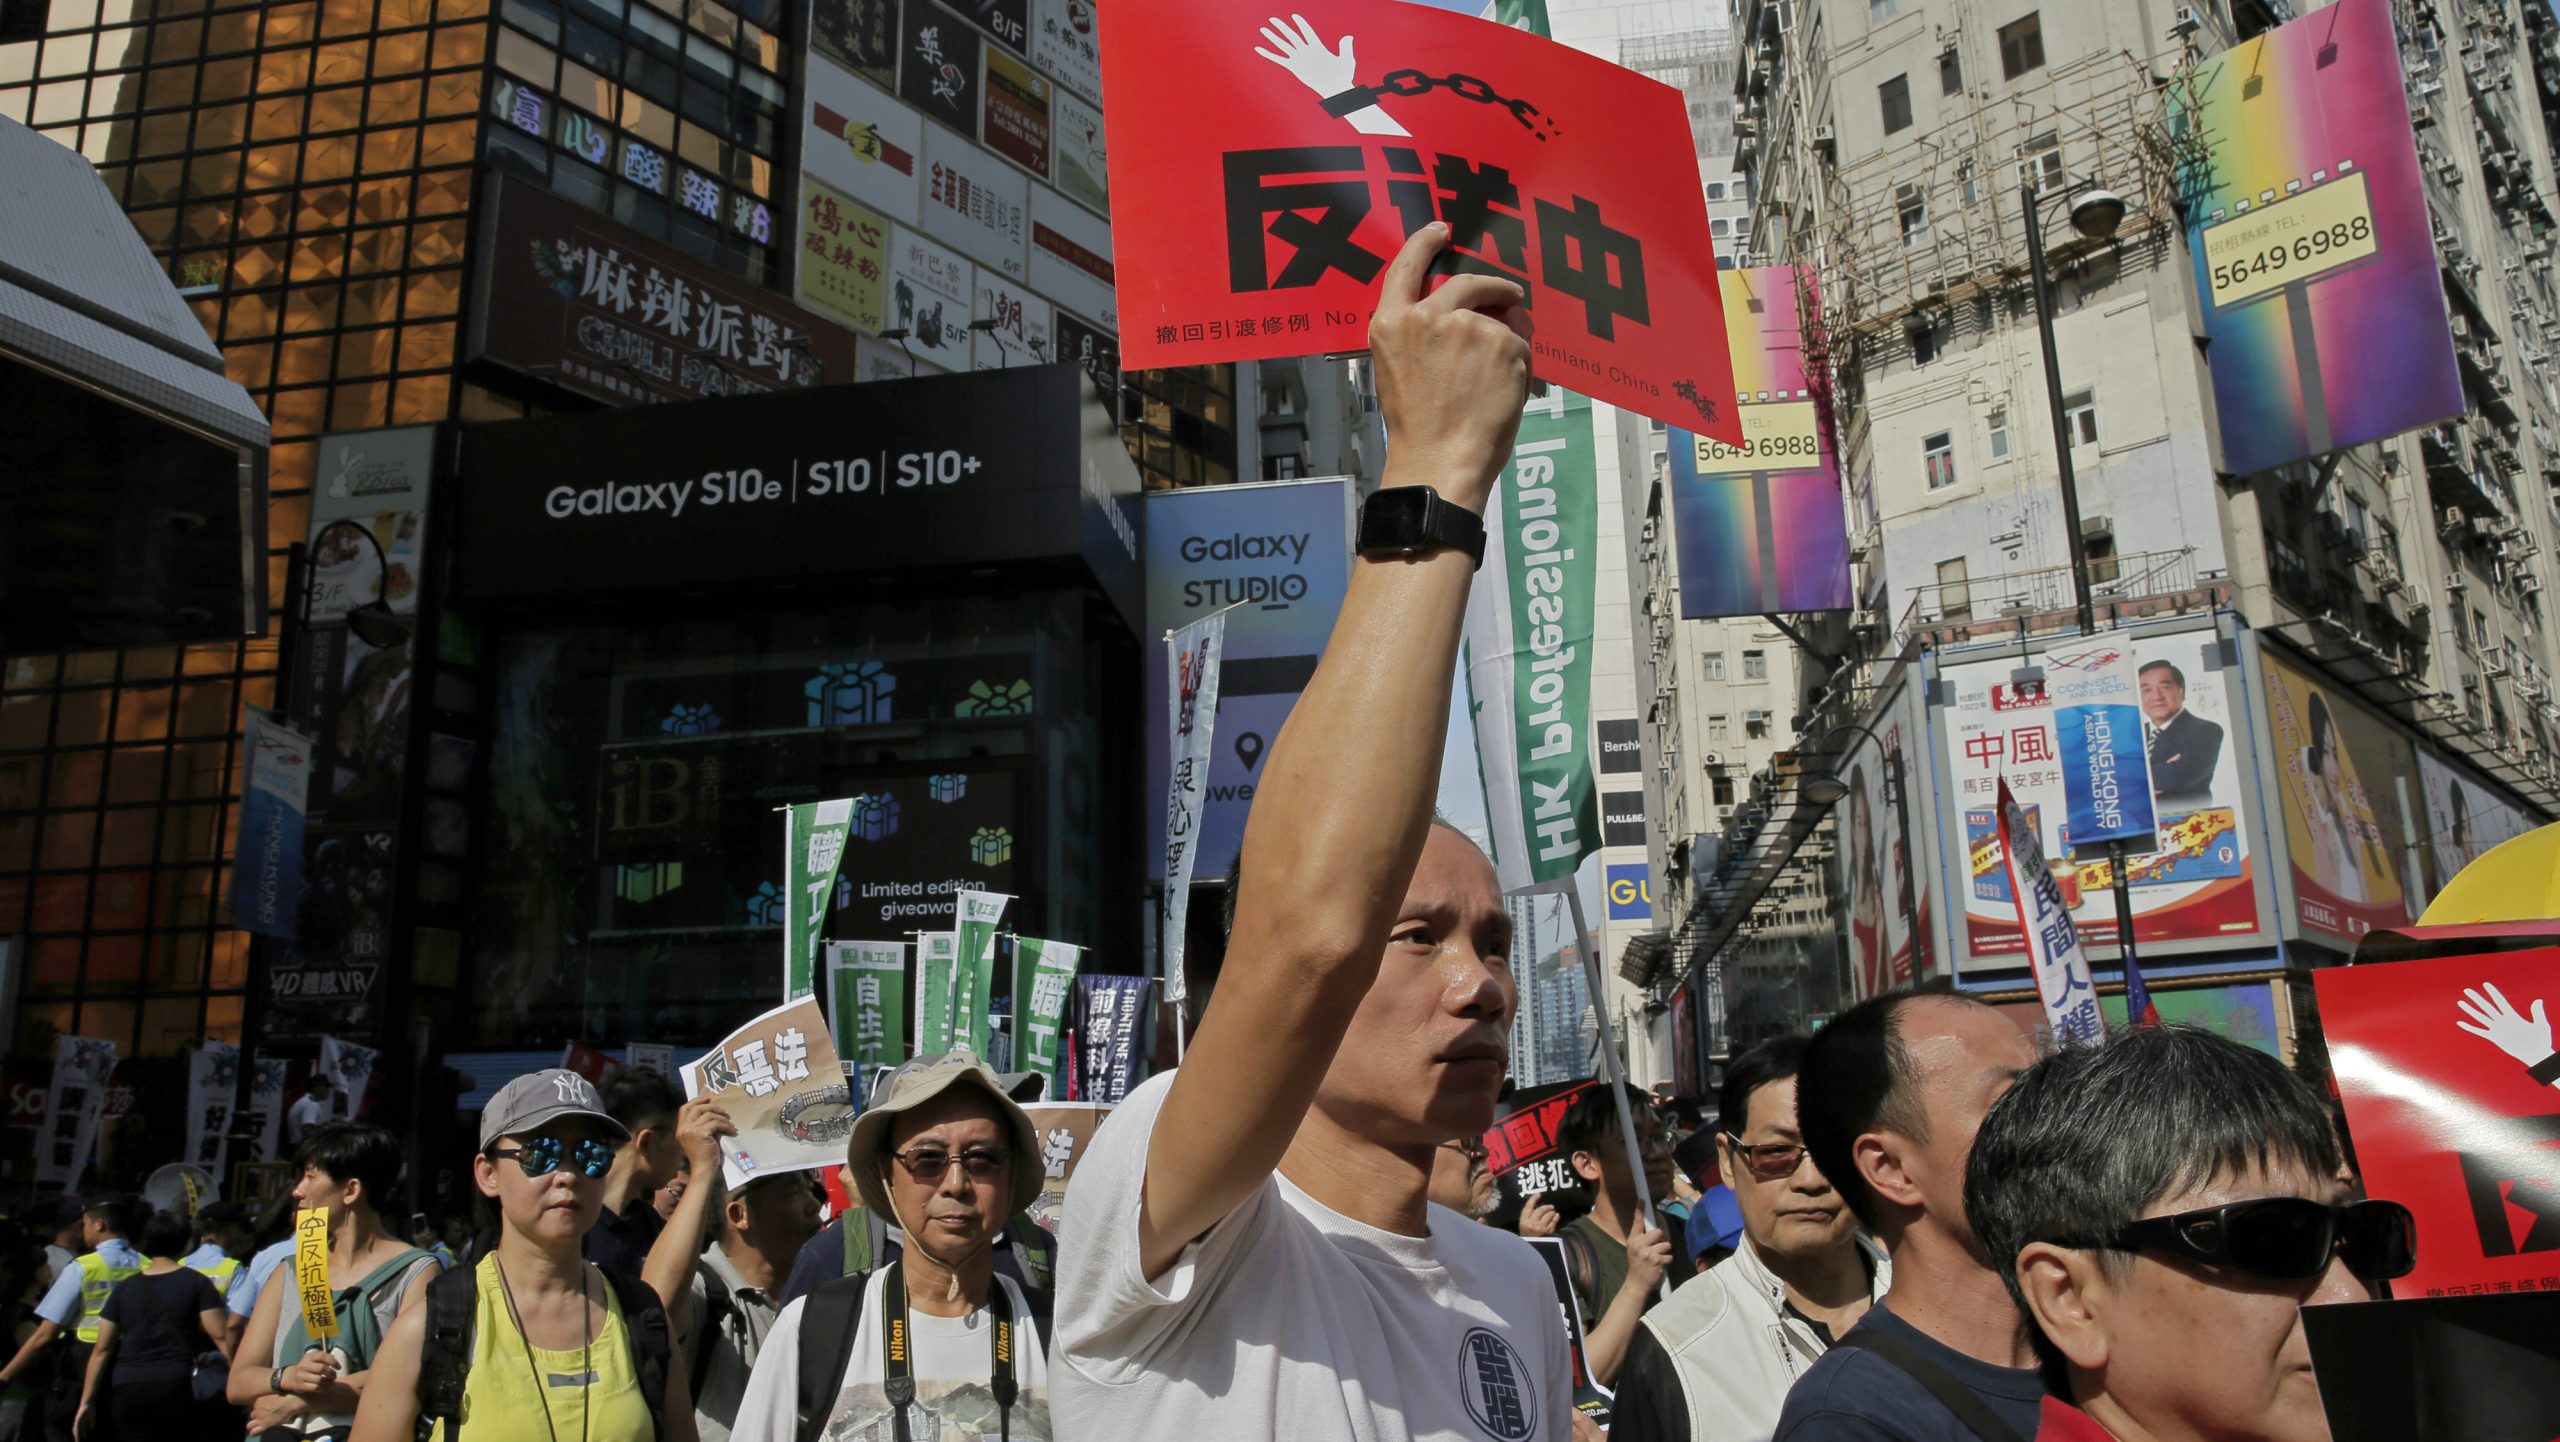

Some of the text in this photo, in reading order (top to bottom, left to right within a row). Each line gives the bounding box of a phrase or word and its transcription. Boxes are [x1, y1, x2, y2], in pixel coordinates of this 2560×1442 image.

[992, 10, 1024, 43] 8/F
[805, 231, 882, 283] 酸辣粉
[1222, 145, 1652, 343] 反送中
[2214, 215, 2370, 290] 5649 6988
[1003, 258, 1023, 274] 6/F
[580, 247, 797, 381] 麻辣派對
[860, 312, 880, 328] 5/F
[1156, 313, 1309, 344] 撤回引渡修例
[1325, 310, 1357, 326] No
[945, 323, 968, 345] 5/F
[1609, 366, 1660, 397] China
[1760, 435, 1816, 457] 6988
[545, 449, 982, 520] Galaxy S10e S10 S10+
[1180, 533, 1310, 564] Galaxy
[1183, 573, 1308, 611] STUDIO
[2057, 674, 2120, 694] CONNECT
[2089, 682, 2132, 697] EXCEL
[1965, 725, 2054, 769] 中風
[2083, 714, 2107, 829] ASIA'S WORLD CITY
[2093, 710, 2122, 829] HONG KONG
[862, 878, 985, 898] Limited edition
[881, 901, 960, 921] giveawa
[1517, 1158, 1581, 1198] 逃犯
[300, 1239, 333, 1328] 反抗極權
[891, 1319, 904, 1361] Nikon
[997, 1321, 1010, 1363] Nikon
